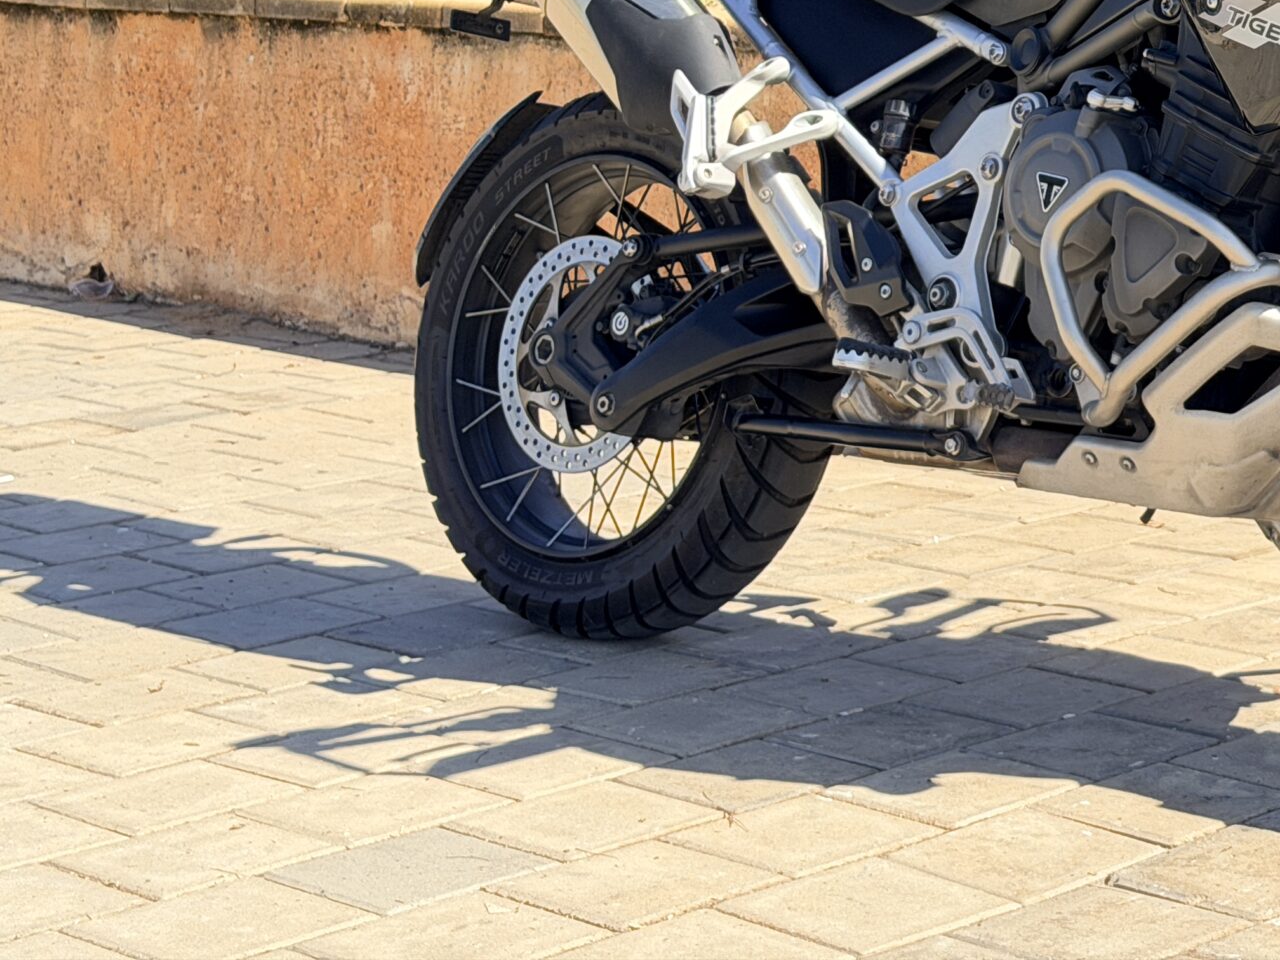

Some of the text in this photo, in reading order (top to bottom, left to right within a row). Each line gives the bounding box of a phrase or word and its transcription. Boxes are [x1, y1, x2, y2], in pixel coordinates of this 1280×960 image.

[439, 148, 551, 315] KAROO STREET
[497, 548, 594, 586] METZELER
